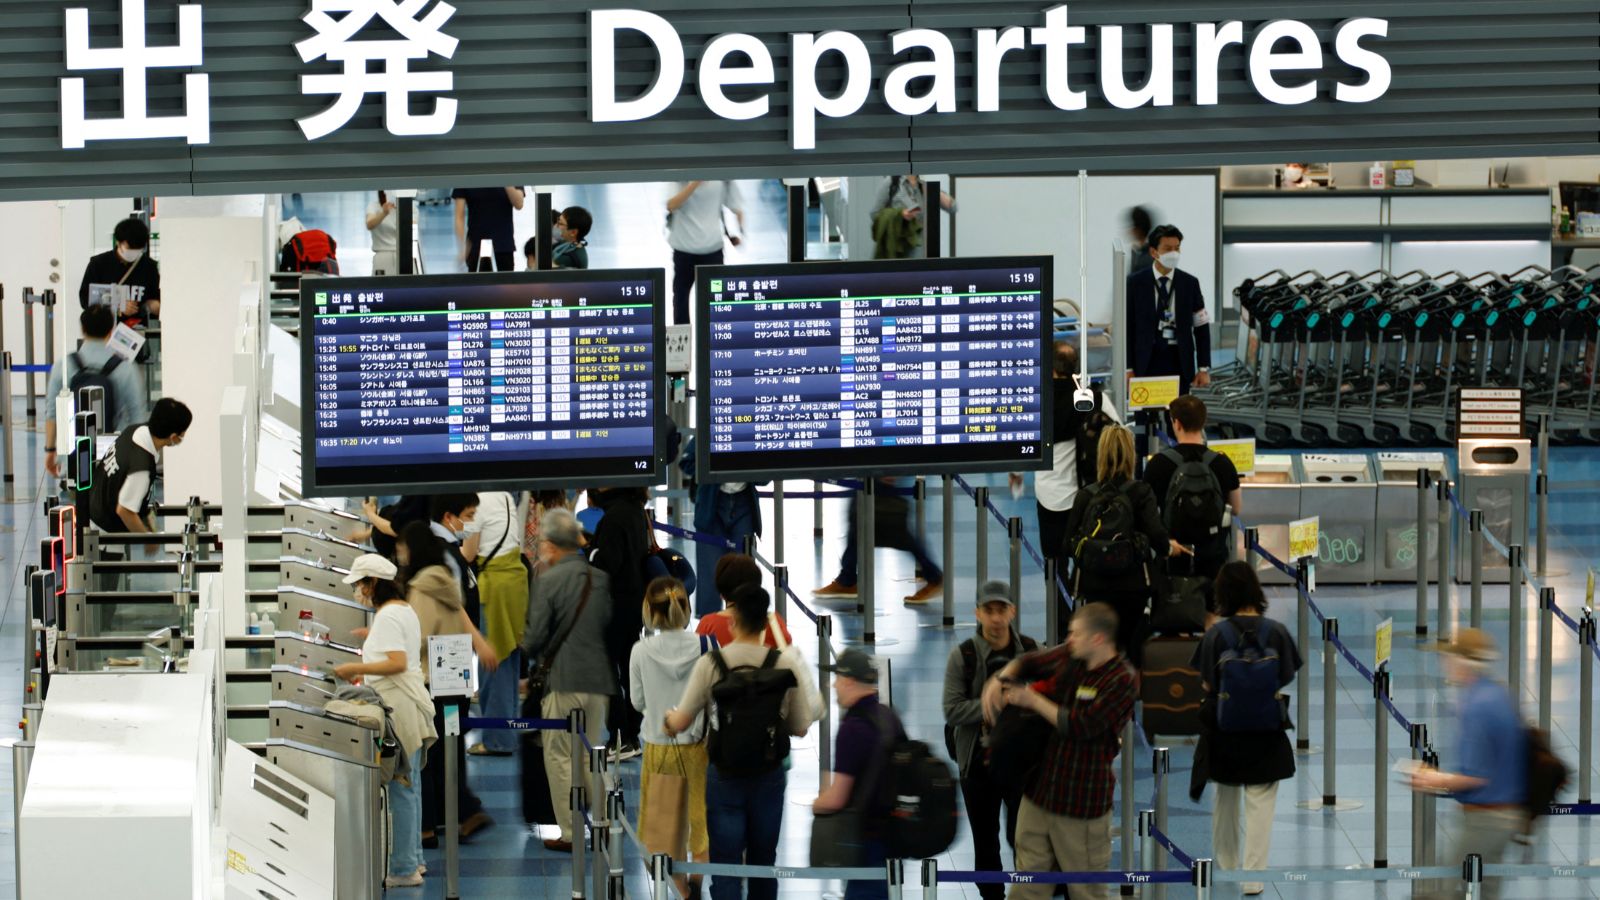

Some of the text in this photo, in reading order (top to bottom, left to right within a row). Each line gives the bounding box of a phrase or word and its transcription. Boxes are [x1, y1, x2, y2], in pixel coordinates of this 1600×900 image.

[589, 4, 1392, 150] Departures
[727, 281, 747, 291] 出発
[332, 294, 352, 303] 出発
[360, 362, 409, 370] サンフランシスコ
[1021, 446, 1034, 454] 2/2
[635, 461, 647, 469] 1/2
